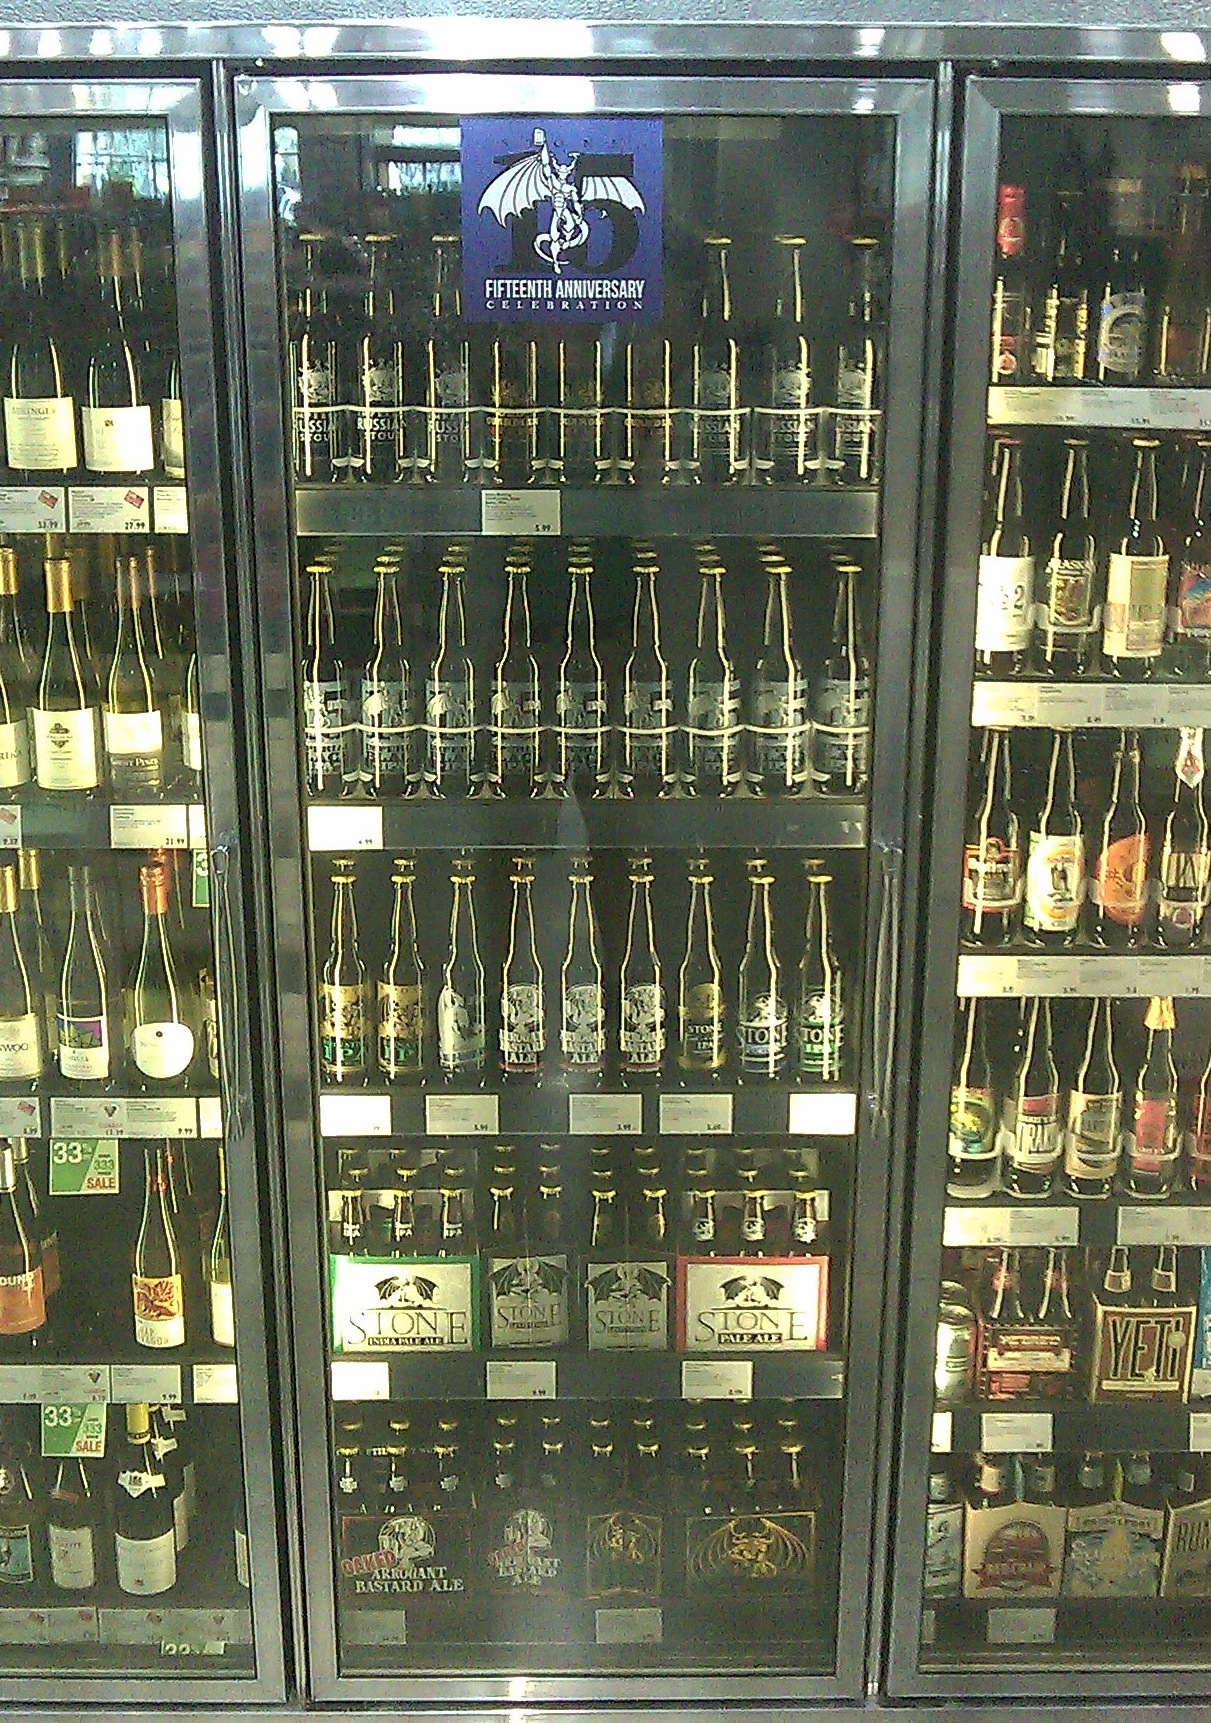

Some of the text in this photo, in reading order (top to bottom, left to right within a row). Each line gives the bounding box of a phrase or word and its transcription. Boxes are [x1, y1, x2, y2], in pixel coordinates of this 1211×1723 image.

[485, 279, 646, 299] FIFTEENTH ANNIVERSARY
[485, 300, 644, 311] CELEBRATION
[52, 1142, 83, 1165] 33
[86, 1177, 116, 1189] SALE
[347, 1311, 468, 1345] STONE
[695, 1310, 808, 1343] STONE
[719, 1333, 783, 1344] PALE ALE
[1110, 1317, 1183, 1380] YETI
[44, 1405, 73, 1427] 33
[75, 1441, 102, 1452] SALE
[355, 1578, 465, 1594] BASTARD ALE
